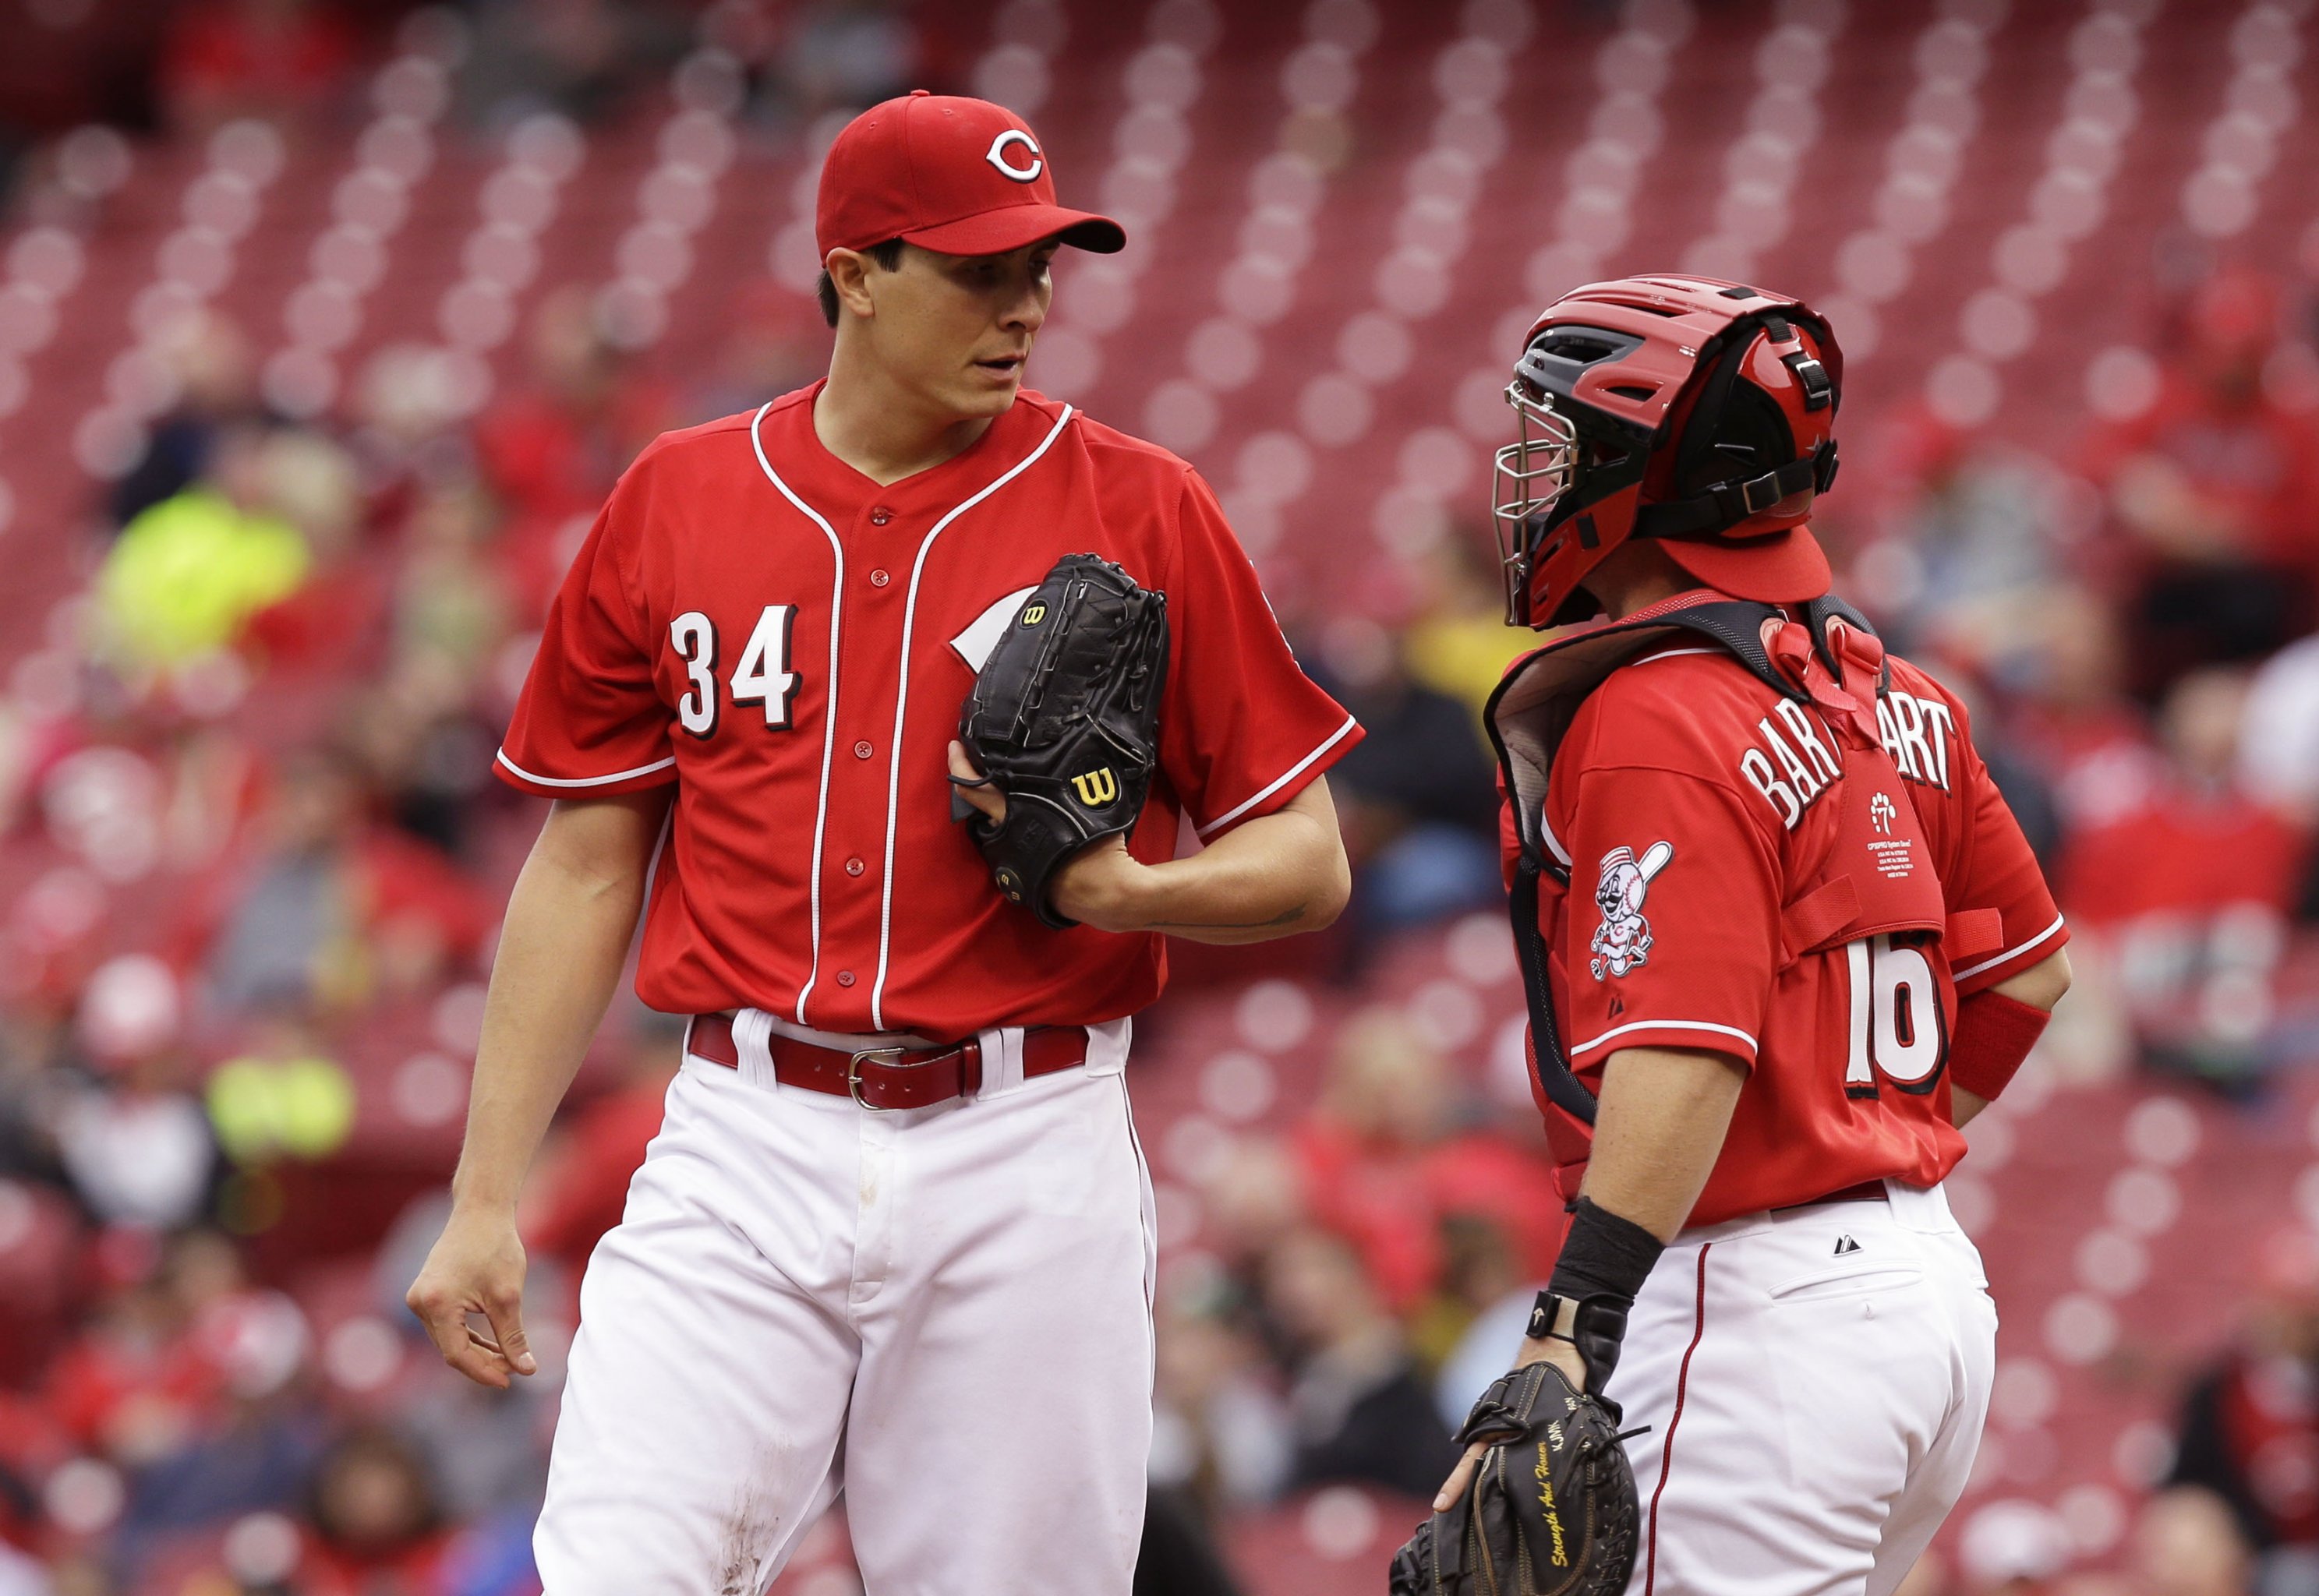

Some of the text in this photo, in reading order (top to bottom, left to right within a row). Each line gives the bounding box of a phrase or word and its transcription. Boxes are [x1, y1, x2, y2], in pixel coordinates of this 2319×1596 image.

[985, 129, 1042, 184] C
[670, 604, 803, 740] 34
[1023, 606, 1046, 625] W
[1070, 767, 1115, 807] W
[1739, 690, 1957, 832] BARART
[1845, 933, 1949, 1099] 16
[1534, 1441, 1569, 1568] Strength And Honor
